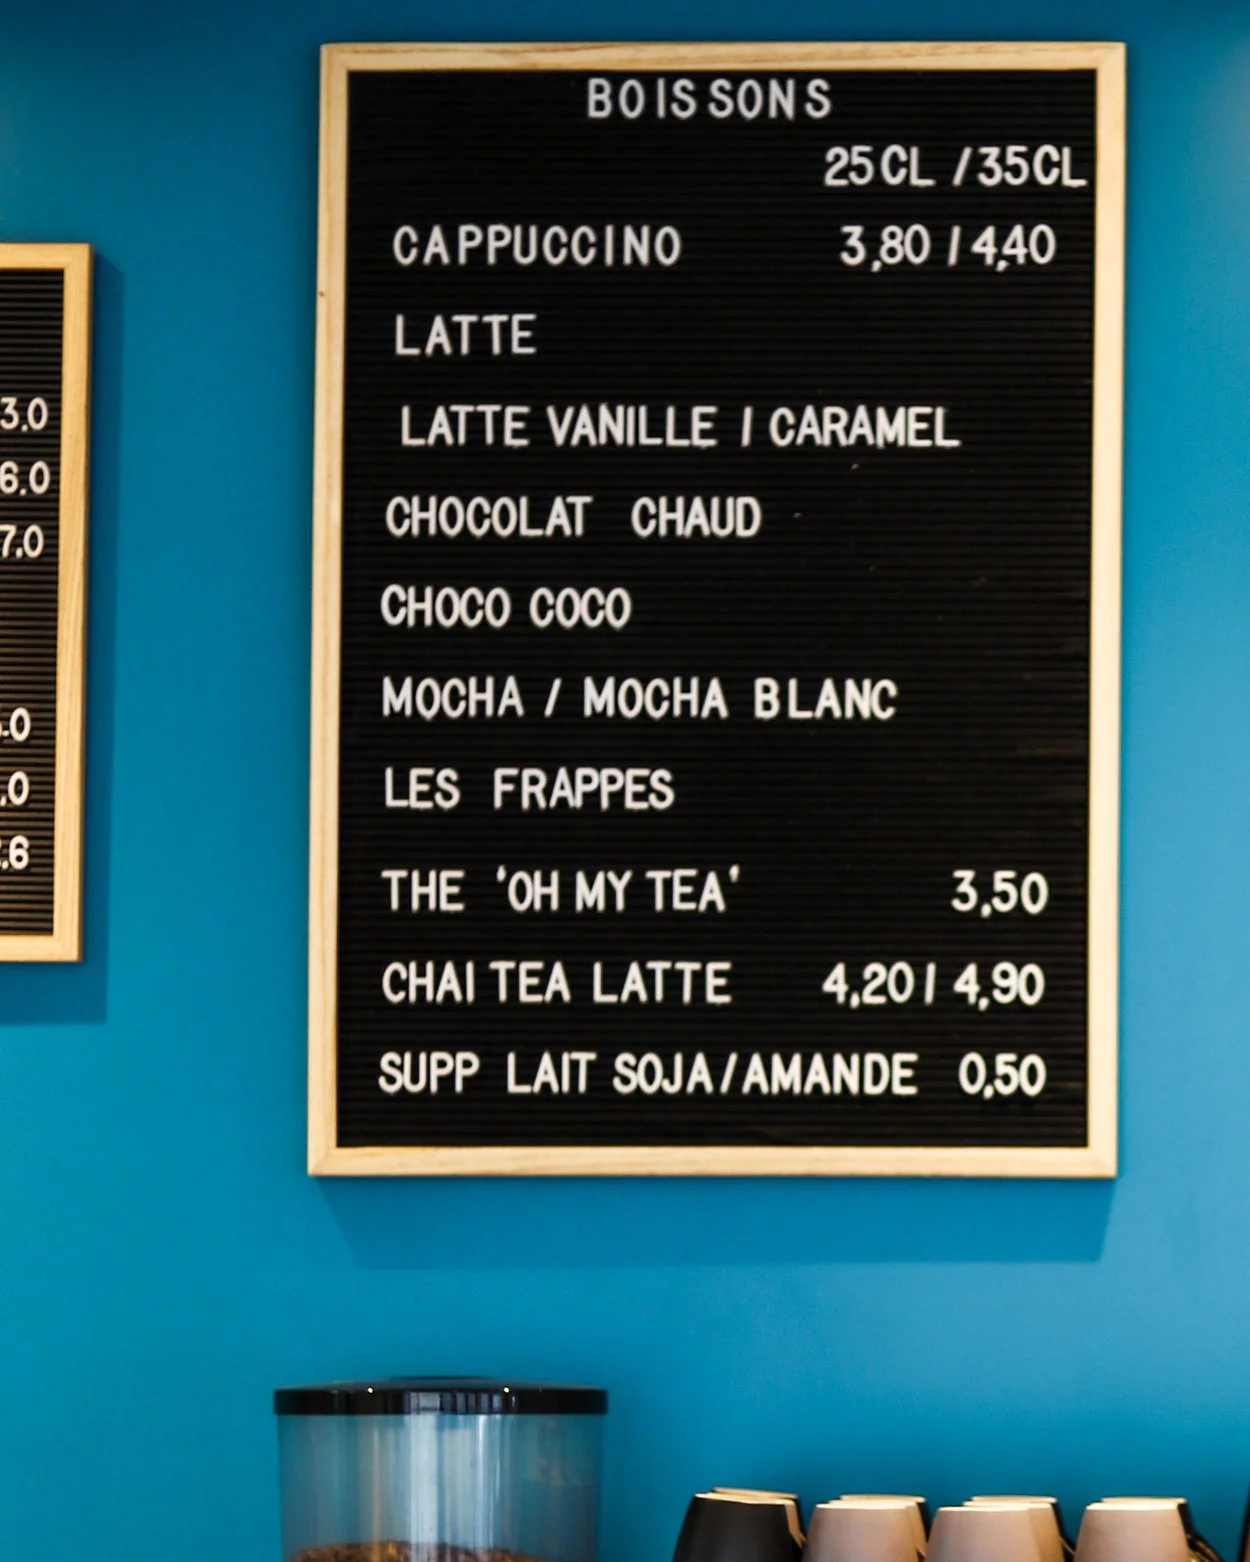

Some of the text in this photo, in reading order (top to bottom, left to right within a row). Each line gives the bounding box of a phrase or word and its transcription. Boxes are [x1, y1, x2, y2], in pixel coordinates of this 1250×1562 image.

[587, 78, 831, 119] BOISSONS
[823, 144, 935, 187] 25CL
[392, 224, 681, 266] CAPPUCCINO
[839, 223, 931, 272] 3,80
[394, 313, 536, 355] LATTE
[400, 404, 530, 447] LATTE
[545, 403, 717, 448] VANILLE
[768, 404, 961, 448] CARAMEL
[384, 495, 762, 537] CHOCOLAT CHAUD
[379, 584, 631, 629] CHOCO COCO
[381, 675, 897, 720] MOCHA / MOCHA BLANC
[384, 766, 675, 810] LES FRAPPES
[380, 869, 465, 912] THE
[574, 870, 632, 912] MY
[950, 869, 1048, 917] 3,50
[381, 960, 475, 1003] CHAI
[488, 960, 571, 1003] TEA
[592, 960, 732, 1005] LATTE
[952, 961, 1045, 1011] 4,90
[377, 1051, 480, 1094] SUPP
[506, 1051, 597, 1094] LAIT
[957, 1052, 1046, 1099] 0,50
